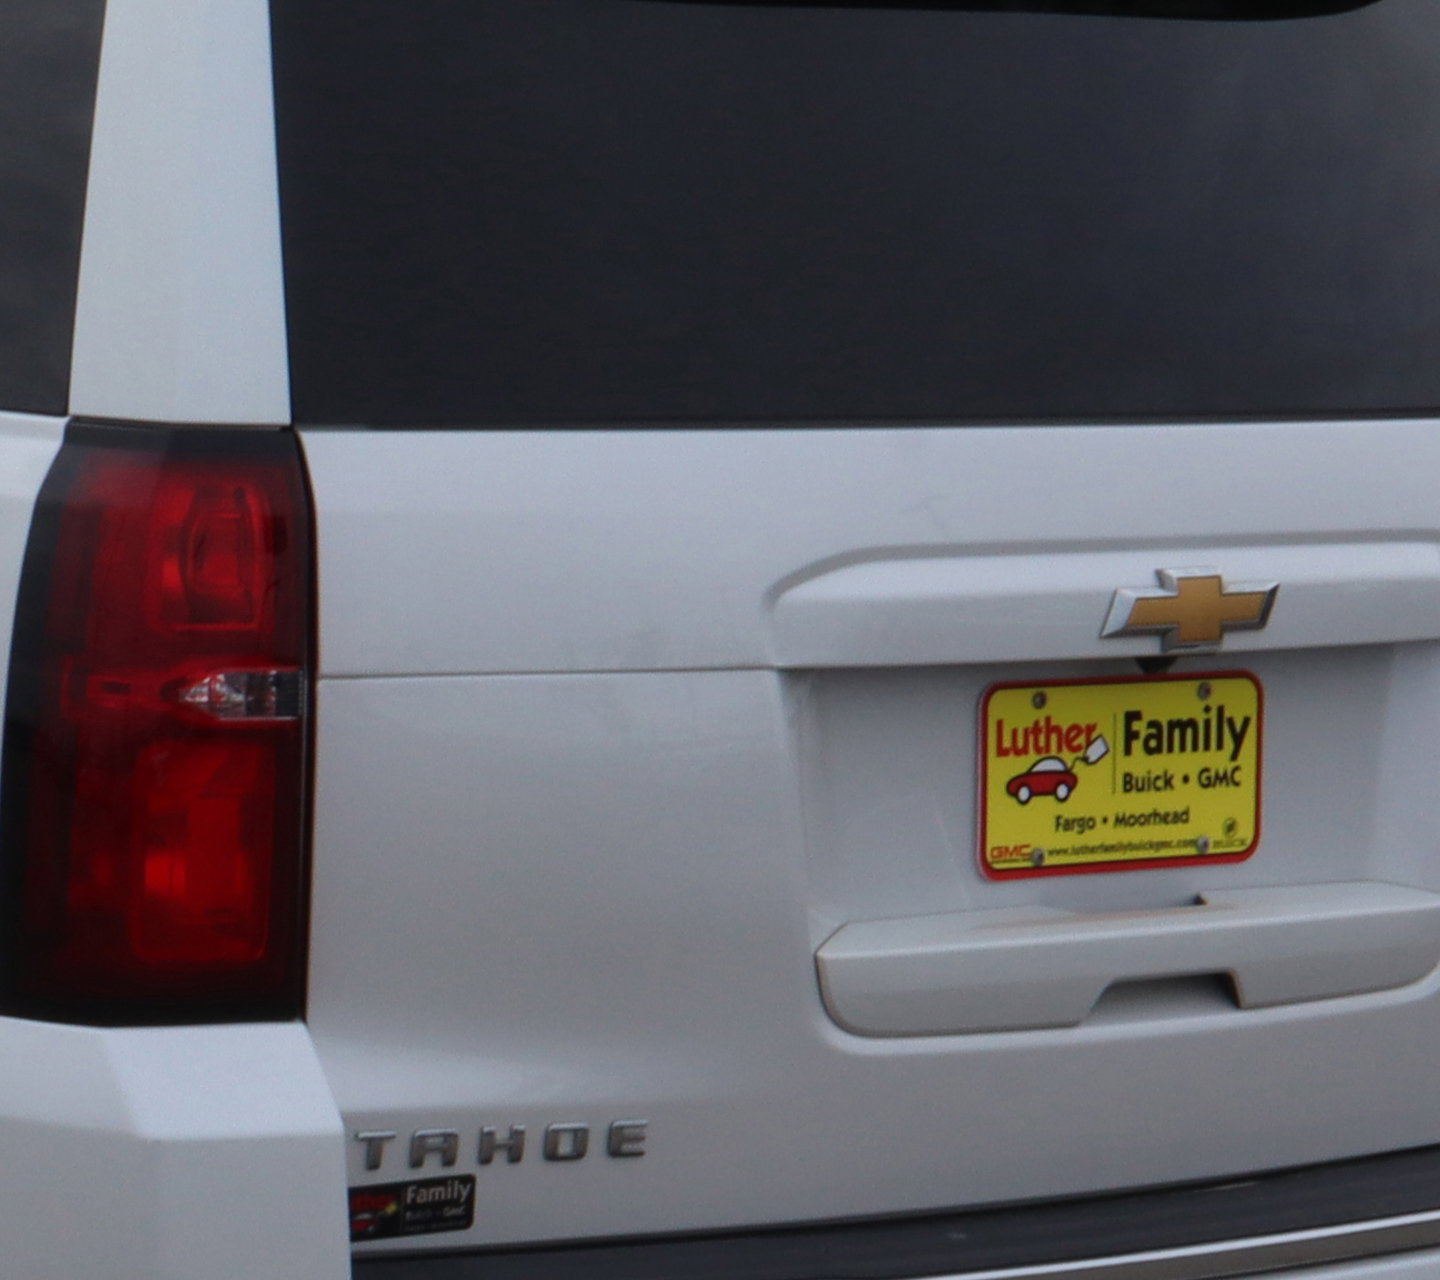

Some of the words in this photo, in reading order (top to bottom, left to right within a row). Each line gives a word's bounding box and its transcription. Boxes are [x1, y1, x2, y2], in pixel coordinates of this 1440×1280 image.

[997, 715, 1098, 757] Luther
[1124, 705, 1251, 762] Family
[1123, 769, 1174, 793] Buick
[1197, 765, 1241, 789] GMC
[1055, 814, 1097, 834] Fargo
[1113, 805, 1190, 828] Moorhead
[990, 844, 1032, 859] GMC
[354, 1118, 649, 1171] TAHOE
[406, 1180, 471, 1204] Family
